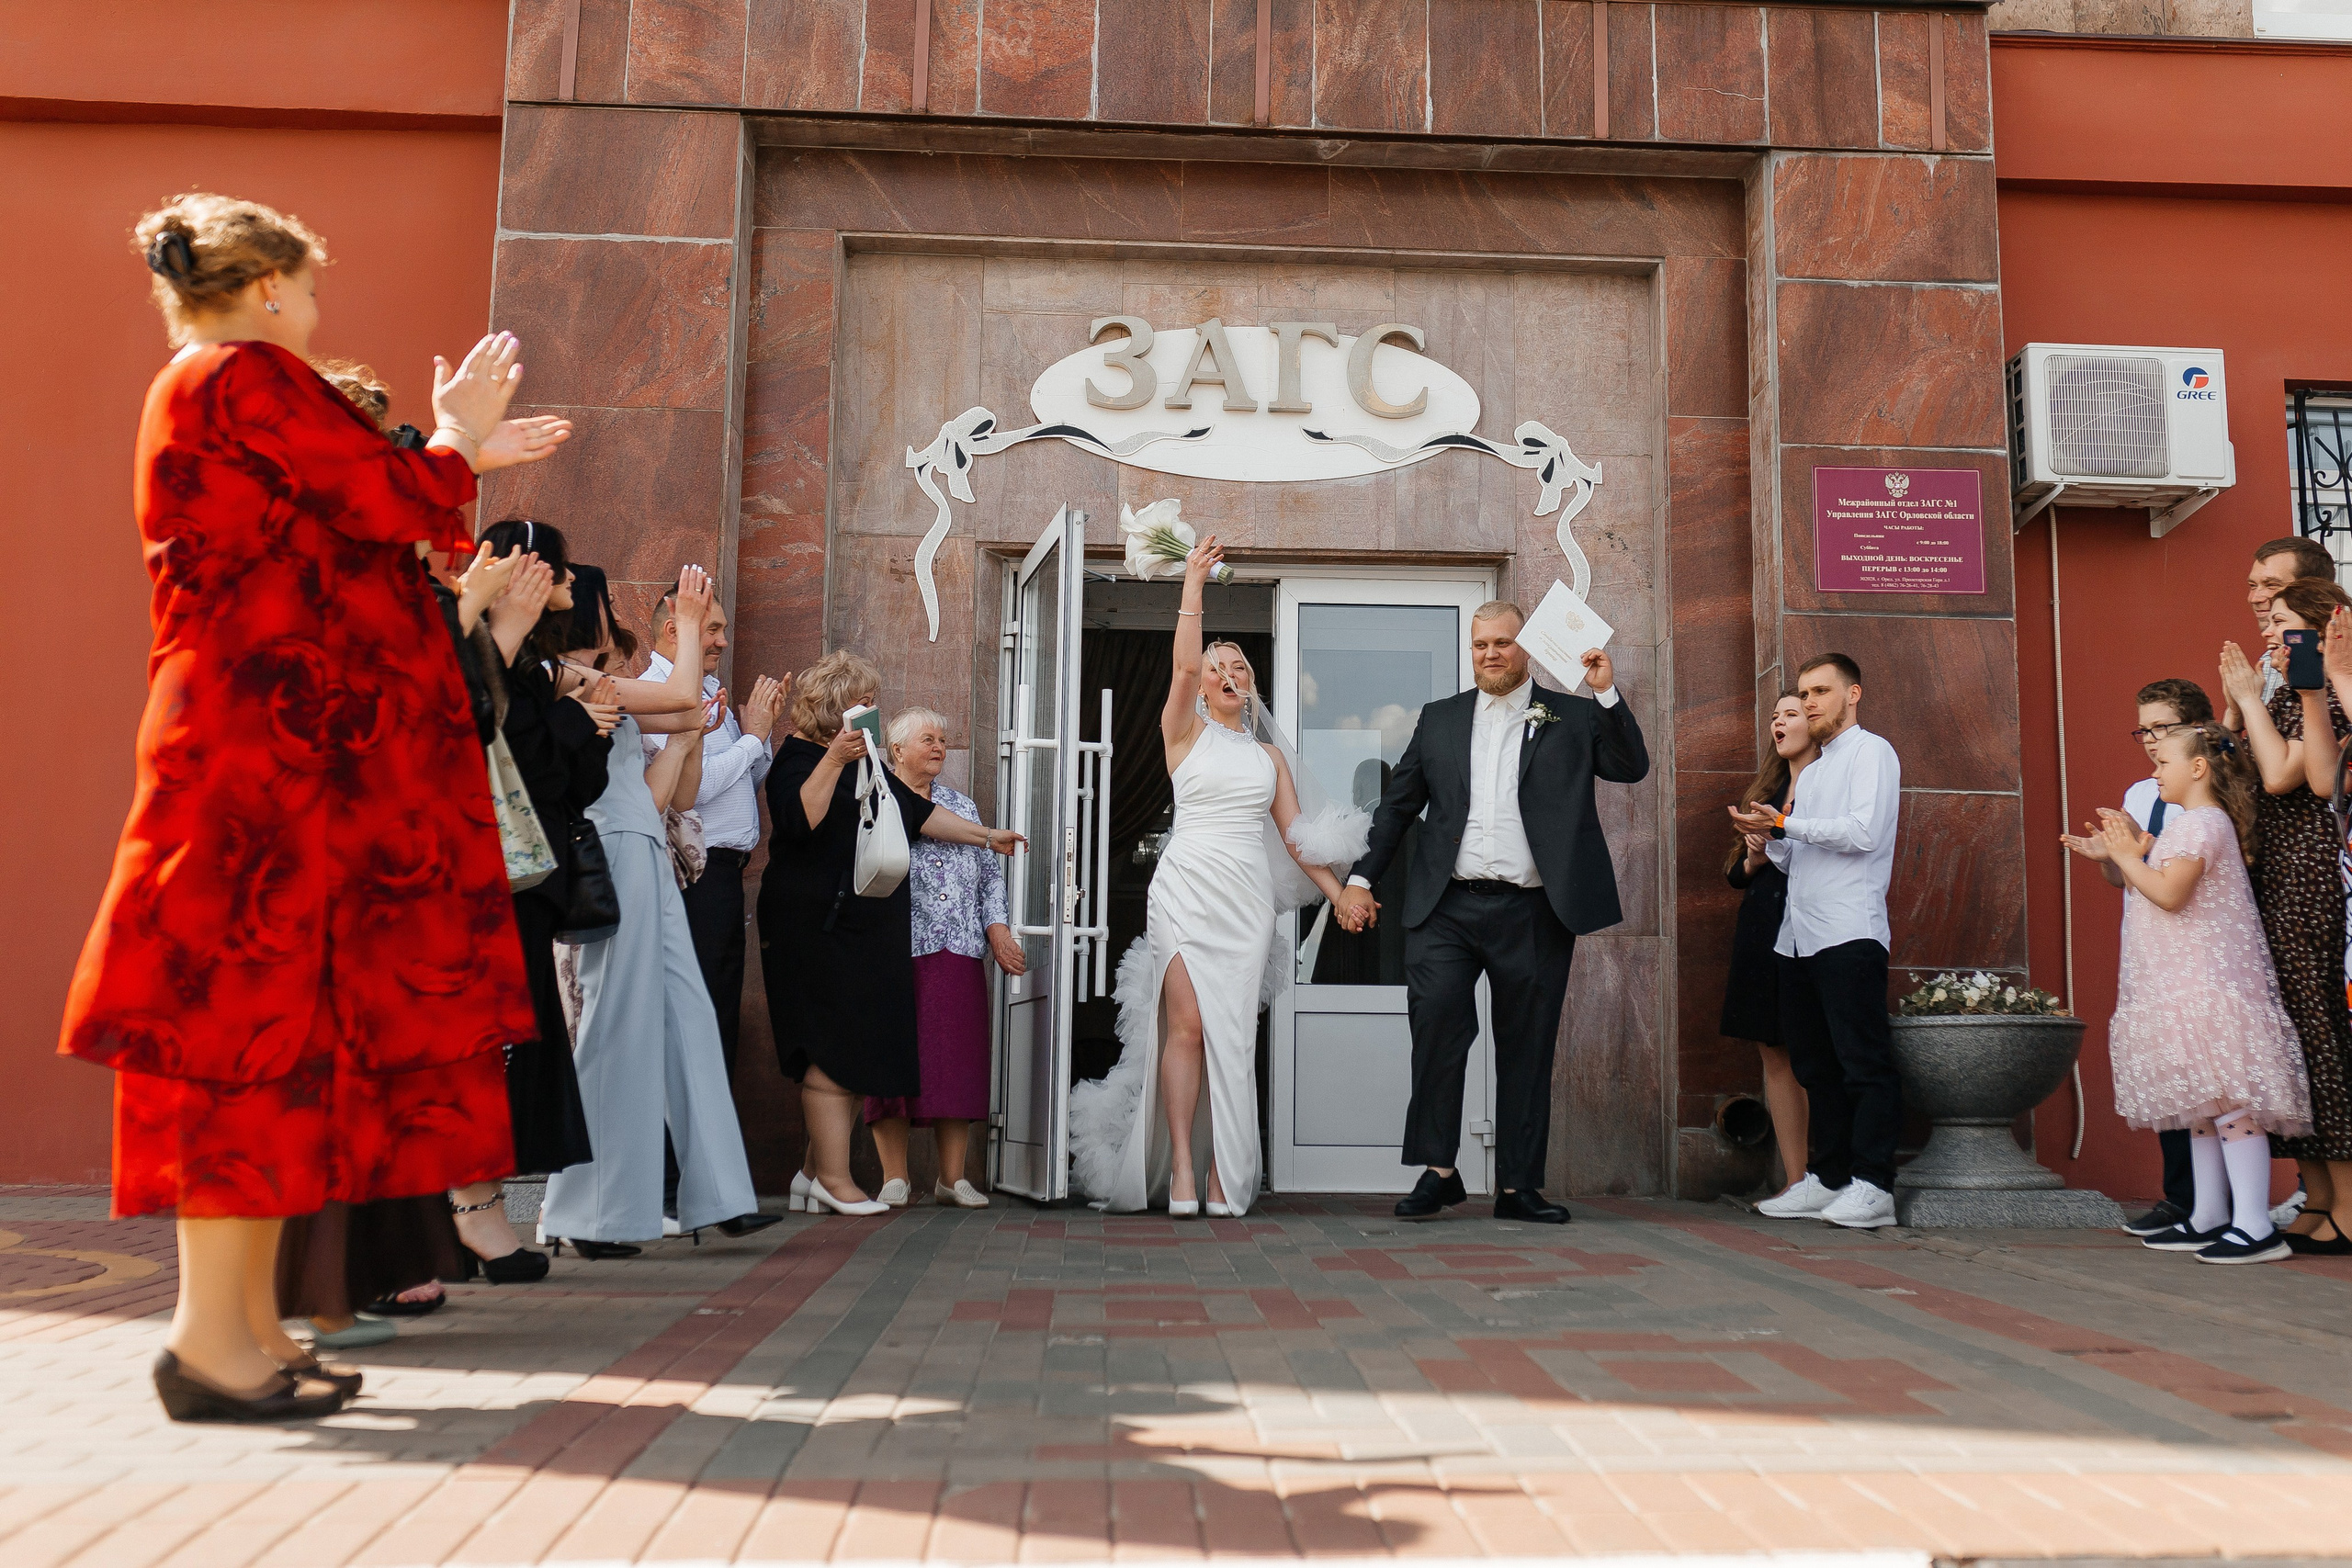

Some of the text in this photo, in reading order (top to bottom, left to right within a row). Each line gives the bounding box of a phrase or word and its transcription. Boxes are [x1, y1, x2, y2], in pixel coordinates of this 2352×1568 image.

[1085, 315, 1429, 419] ЗАГС
[2177, 390, 2217, 400] GREE
[1838, 498, 1958, 508] Межрайонный отдел ЗАГС №1
[1826, 510, 1974, 521] Управления ЗАГС Орловской области
[1885, 555, 1908, 563] ДЕНЬ:
